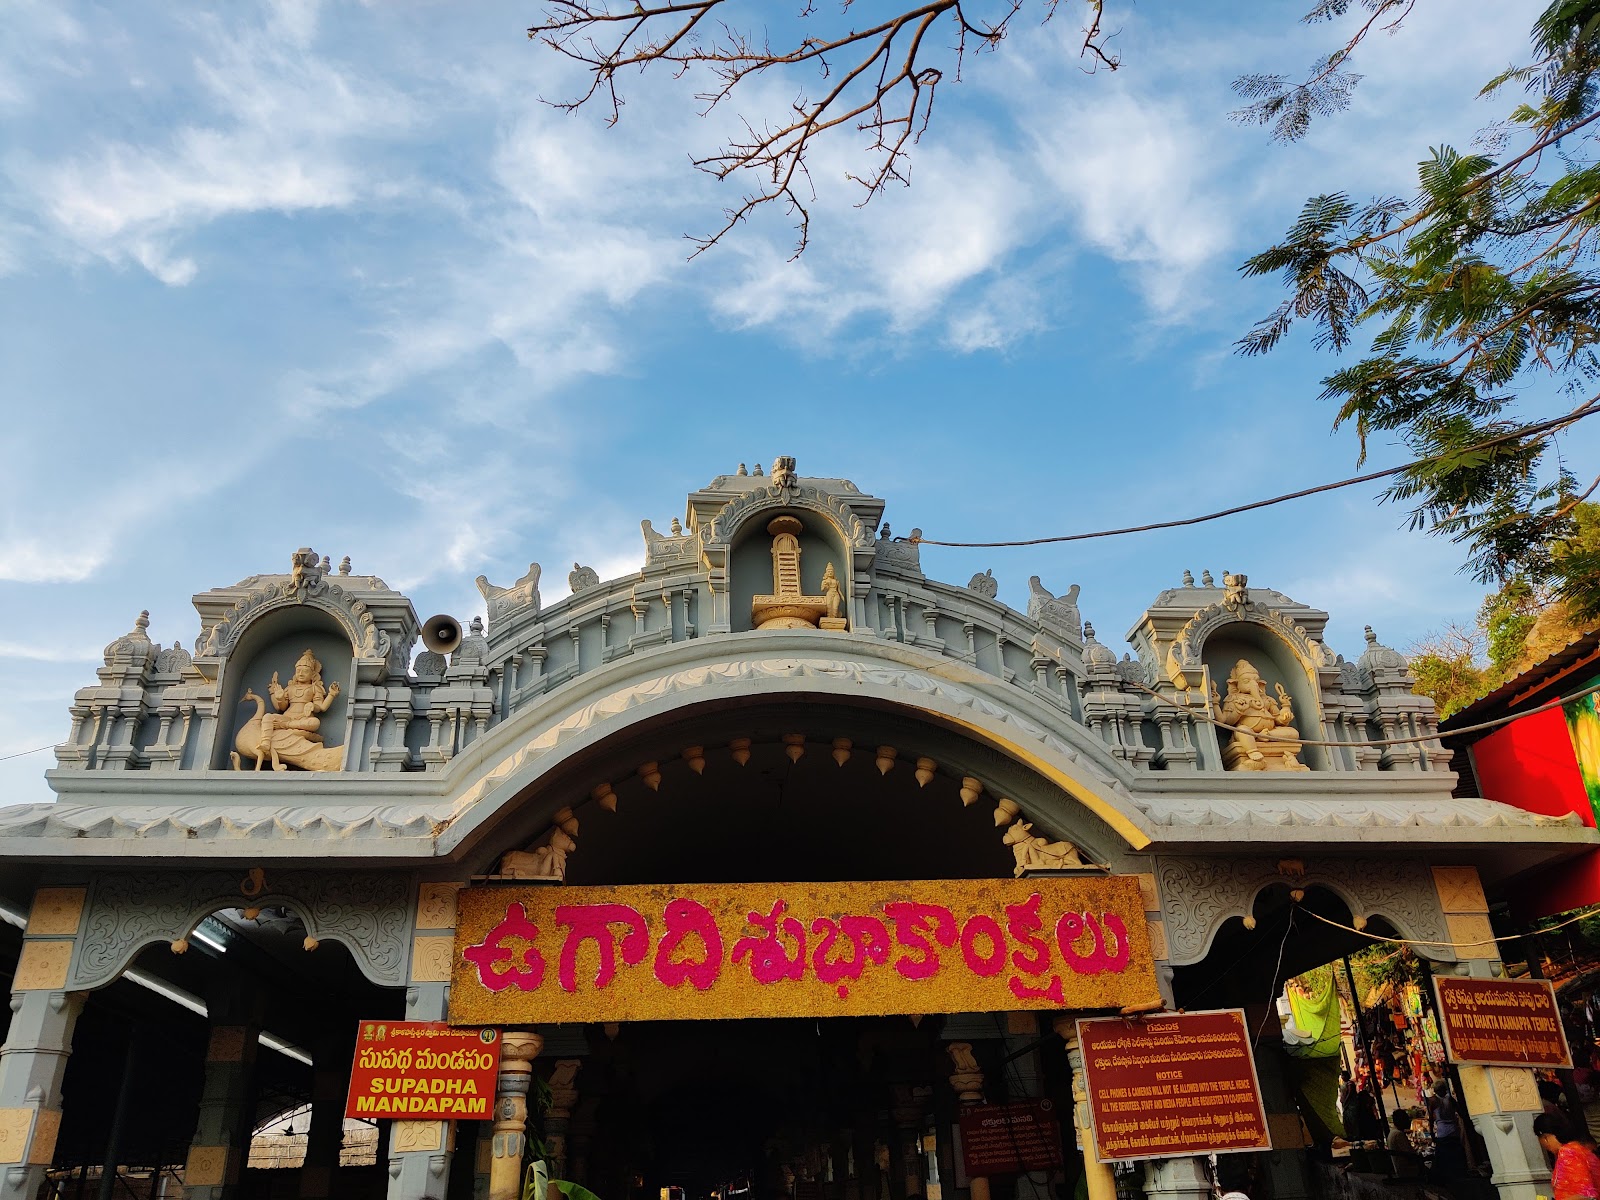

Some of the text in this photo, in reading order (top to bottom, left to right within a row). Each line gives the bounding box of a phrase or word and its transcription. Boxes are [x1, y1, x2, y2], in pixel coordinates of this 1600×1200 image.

[1147, 1022, 1179, 1032] గమనిక
[1450, 1013, 1556, 1031] WAY TO BHAKTA KANNAPPA TEMPLE
[415, 1047, 494, 1071] మండపం
[1156, 1070, 1184, 1080] NOTICE
[369, 1077, 478, 1095] SUPADHA
[1098, 1089, 1110, 1099] CELL
[1109, 1088, 1127, 1099] PHONES
[1127, 1087, 1132, 1097] &
[1131, 1086, 1152, 1097] CAMERAS
[1151, 1085, 1163, 1096] WILL
[1162, 1085, 1172, 1095] NOT
[1173, 1084, 1180, 1094] BE
[1179, 1083, 1199, 1094] ALLOWED
[1198, 1082, 1210, 1092] INTO
[1209, 1081, 1219, 1091] THE
[1235, 1079, 1251, 1090] HENCE
[355, 1096, 487, 1113] MANDAPAM
[1101, 1102, 1110, 1113] ALL
[1109, 1102, 1119, 1112] THE
[1141, 1100, 1154, 1110] STAFF
[1153, 1099, 1163, 1110] AND
[1162, 1098, 1176, 1109] MEDIA
[1175, 1097, 1192, 1108] PEOPLE
[1191, 1096, 1201, 1107] ARE
[1200, 1095, 1224, 1106] REQUESTED
[1223, 1094, 1230, 1104] TO
